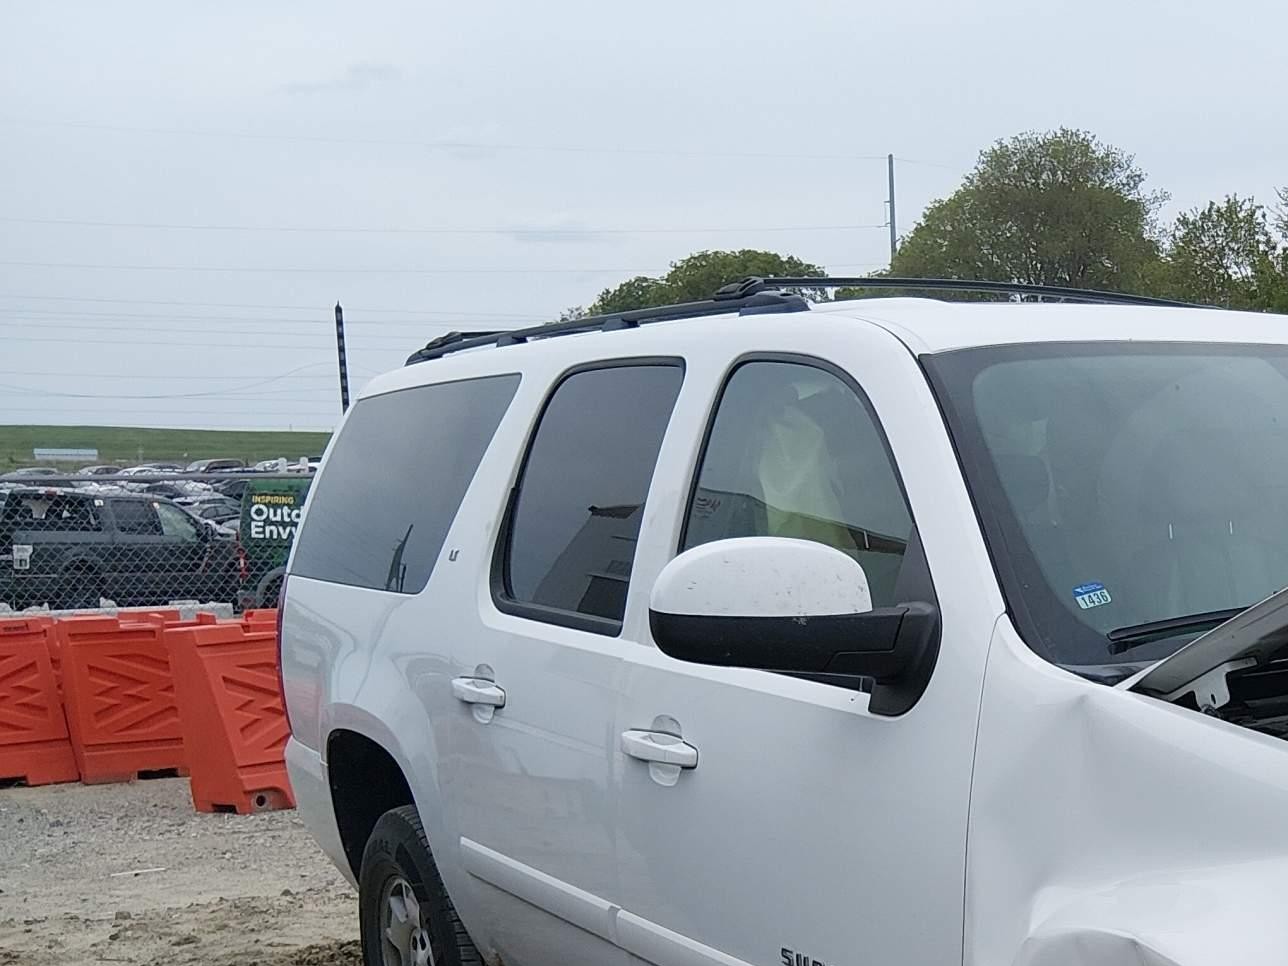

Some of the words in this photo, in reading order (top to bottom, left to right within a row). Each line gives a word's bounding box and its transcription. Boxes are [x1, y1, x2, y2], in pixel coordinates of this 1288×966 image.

[252, 496, 294, 504] INSPIRING
[449, 550, 459, 561] LT
[1081, 591, 1108, 607] 1436
